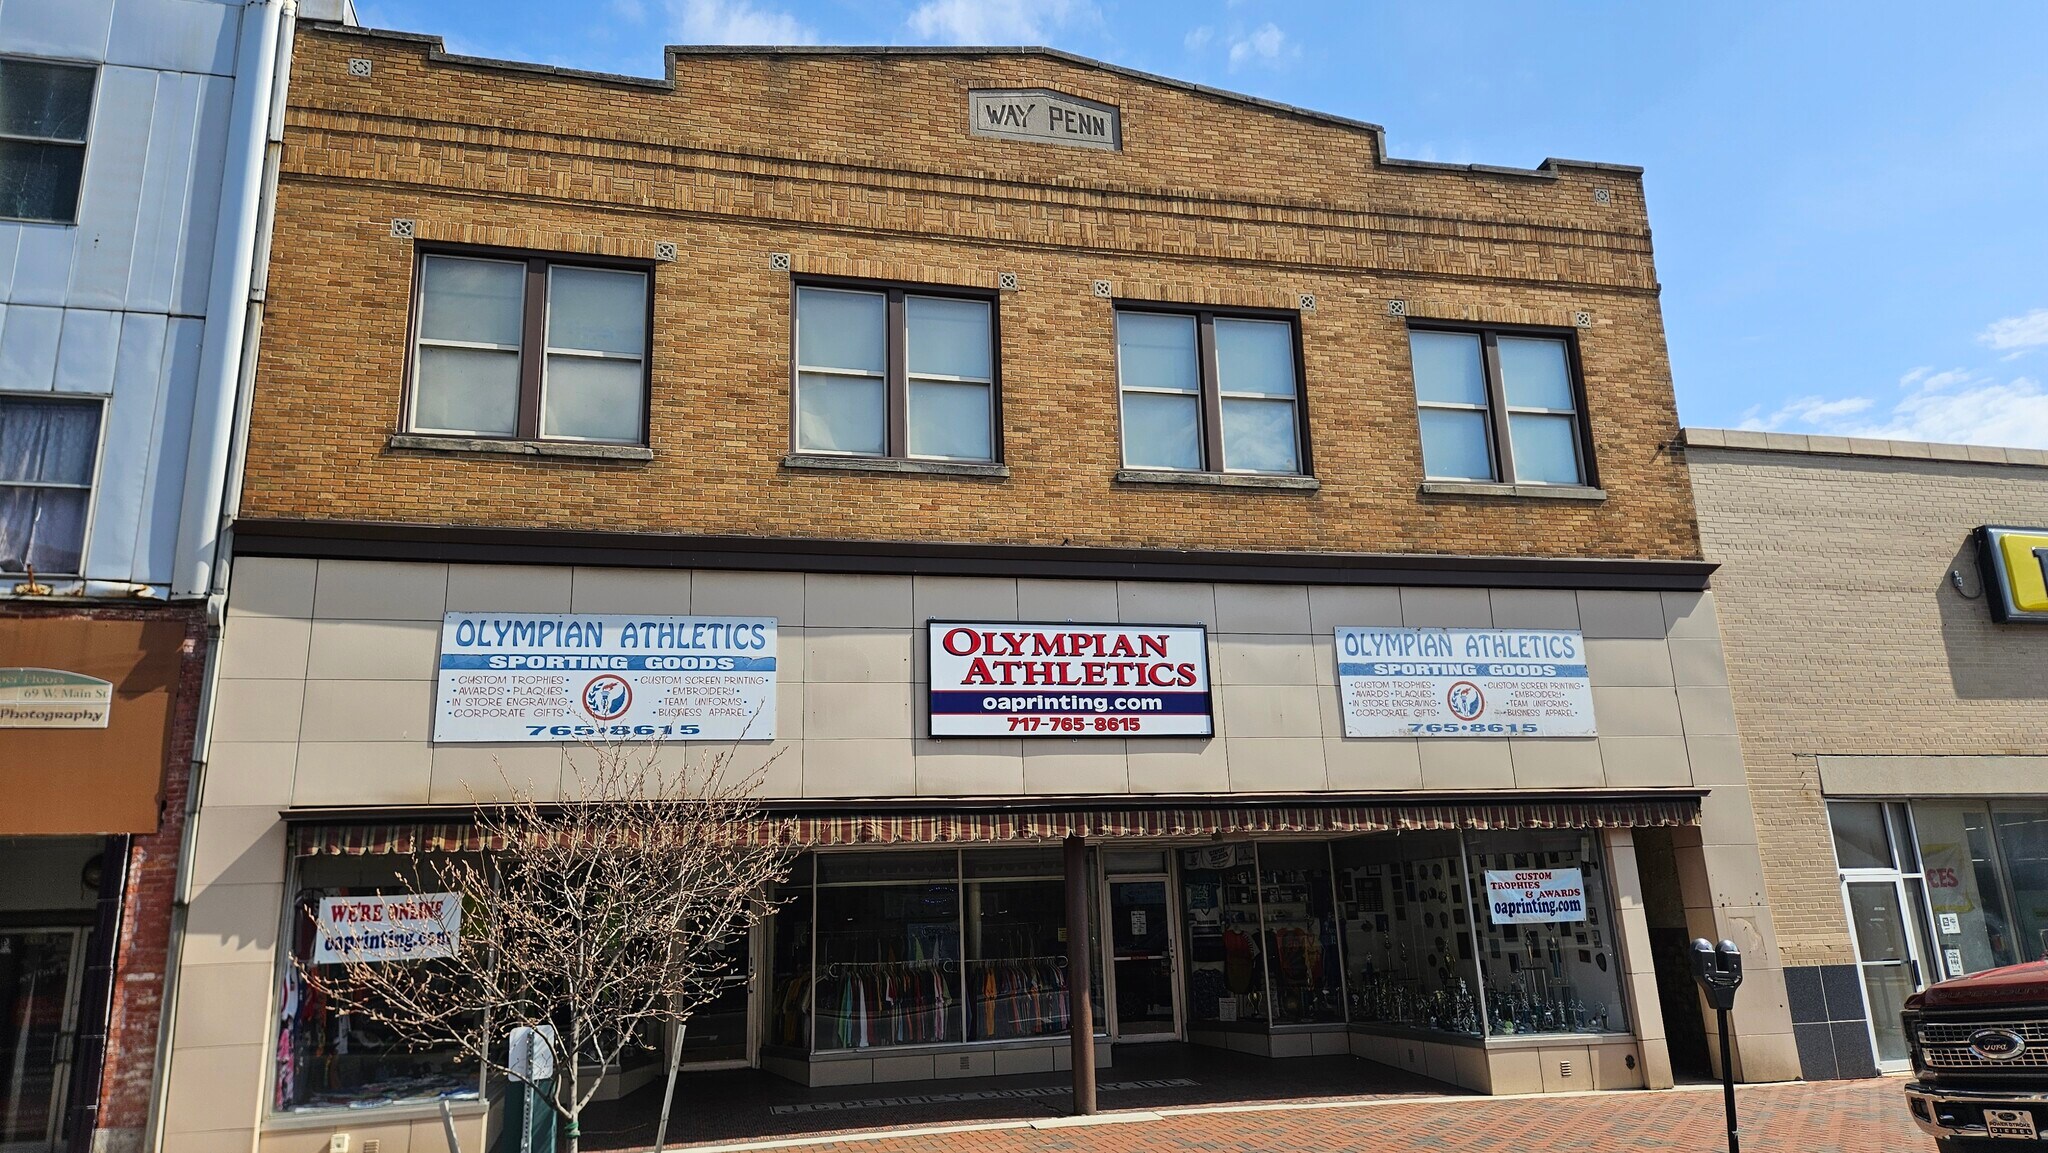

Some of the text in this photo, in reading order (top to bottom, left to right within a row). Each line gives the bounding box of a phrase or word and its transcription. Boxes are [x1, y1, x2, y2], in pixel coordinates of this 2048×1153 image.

[986, 104, 1105, 136] WAY PENN
[455, 619, 766, 650] OLYMPIAN ATHLETICS
[942, 627, 1170, 658] OLYMPIAN
[1344, 633, 1576, 659] OLYMPIAN ATHLETICS
[488, 655, 735, 671] SPORTING GOODS
[960, 657, 1197, 687] ATHLETICS
[1373, 663, 1557, 677] SPORTING GOODS
[24, 674, 65, 685] Floors
[458, 676, 564, 685] CUSTOM TROPHIES
[640, 676, 764, 685] CUSTOM SCREEN PRINTING
[1354, 681, 1432, 689] CUSTOM TROPHIES
[1487, 681, 1581, 690] CUSTOM SCREEN PRINTING
[24, 689, 39, 699] 69
[61, 689, 91, 699] Main
[458, 686, 563, 697] AWARDS PLAQUES
[672, 687, 735, 696] EMBROIDERY
[1355, 690, 1432, 699] AWARDS PLAQUES
[1514, 691, 1562, 699] EMBROIDERY
[452, 697, 568, 707] IN STORE ENGRAVING
[664, 697, 742, 706] TEAM UNIFORMS
[982, 695, 1163, 713] oaprinting.com
[1352, 699, 1437, 707] IN STORE ENGRAVING
[1509, 700, 1569, 708] TEAM UNIFORMS
[0, 708, 103, 722] Photography
[453, 708, 565, 718] CORPORATE GIFTS
[658, 707, 748, 717] BUSINESS APPAREL
[1355, 708, 1437, 718] CORPORATE GIFTS
[1506, 709, 1574, 717] BUSINESS APPAREL
[1006, 717, 1141, 732] 717-765-8615
[1515, 872, 1552, 880] CUSTOM
[1490, 881, 1541, 890] TROPHIES
[1525, 888, 1581, 898] & AWARDS
[331, 901, 444, 923] WE'RE ONLINE
[1494, 898, 1582, 917] oaprinting.com
[325, 930, 452, 953] oaprinting.com
[1983, 1039, 2008, 1051] Ford
